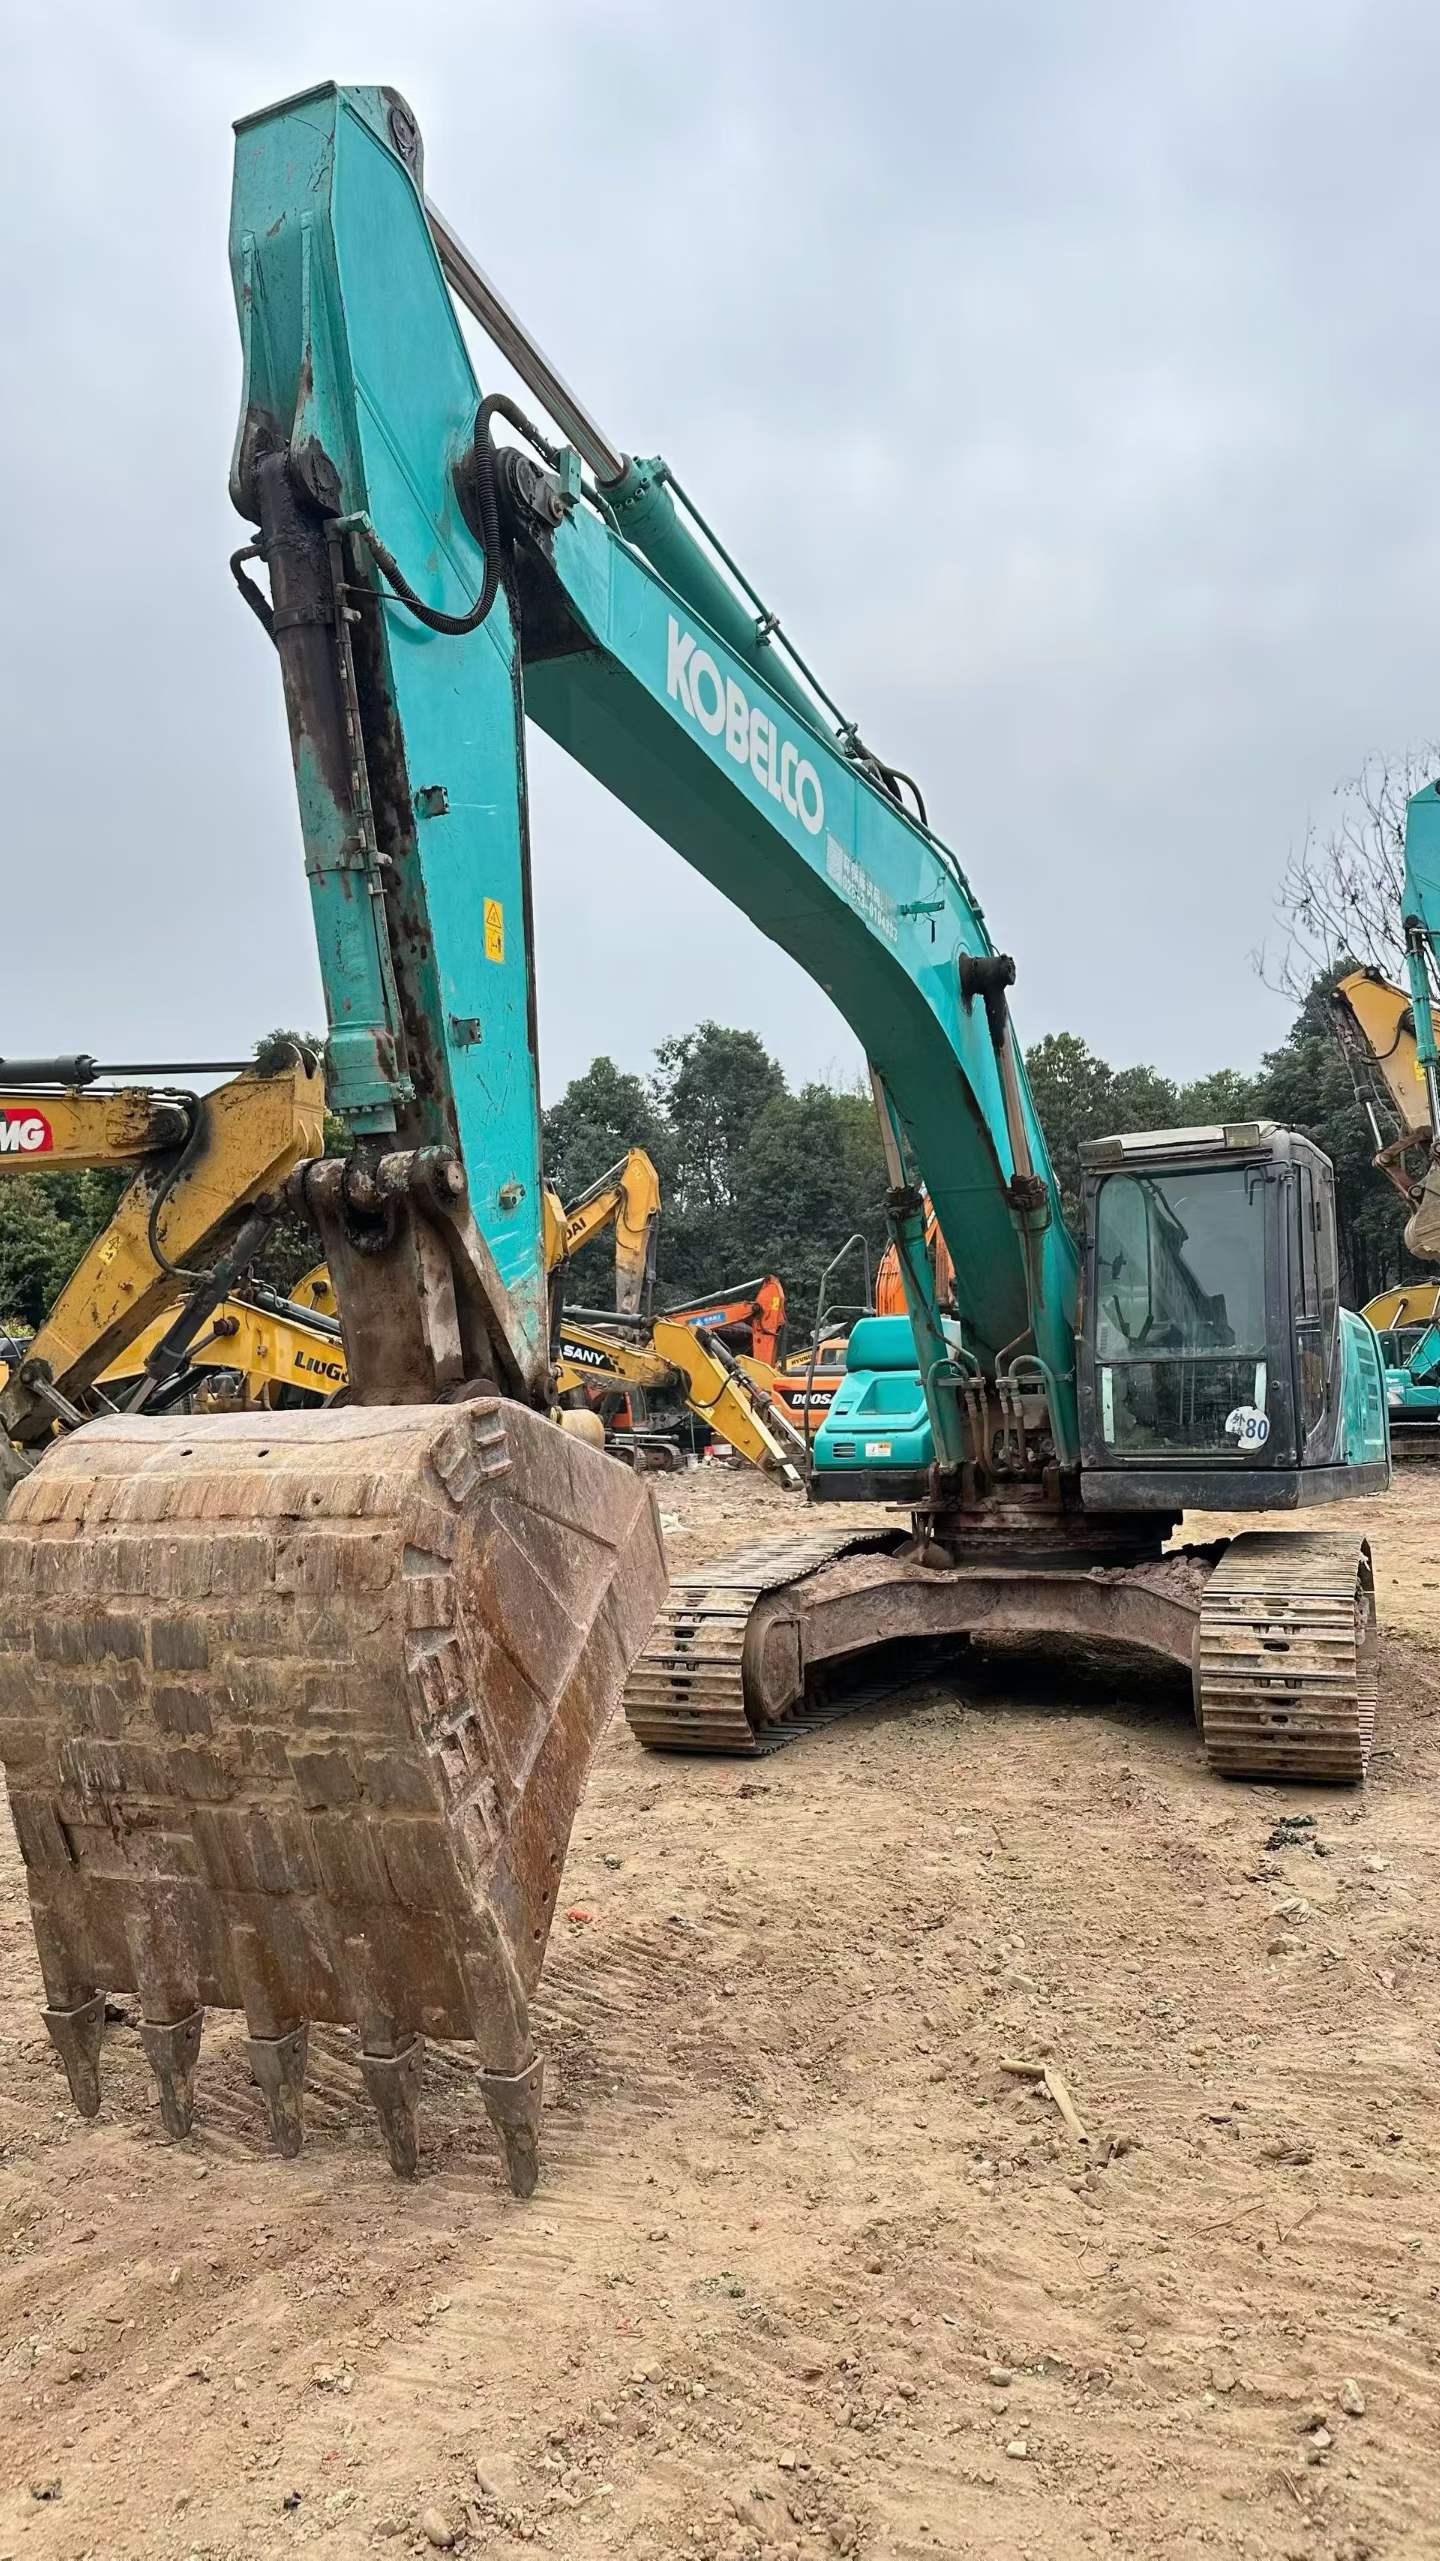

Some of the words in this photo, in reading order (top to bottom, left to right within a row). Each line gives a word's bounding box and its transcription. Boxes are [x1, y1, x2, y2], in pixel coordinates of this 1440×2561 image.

[667, 613, 824, 835] KOBELCO
[563, 1344, 605, 1365] SANY
[1245, 1417, 1268, 1440] 80
